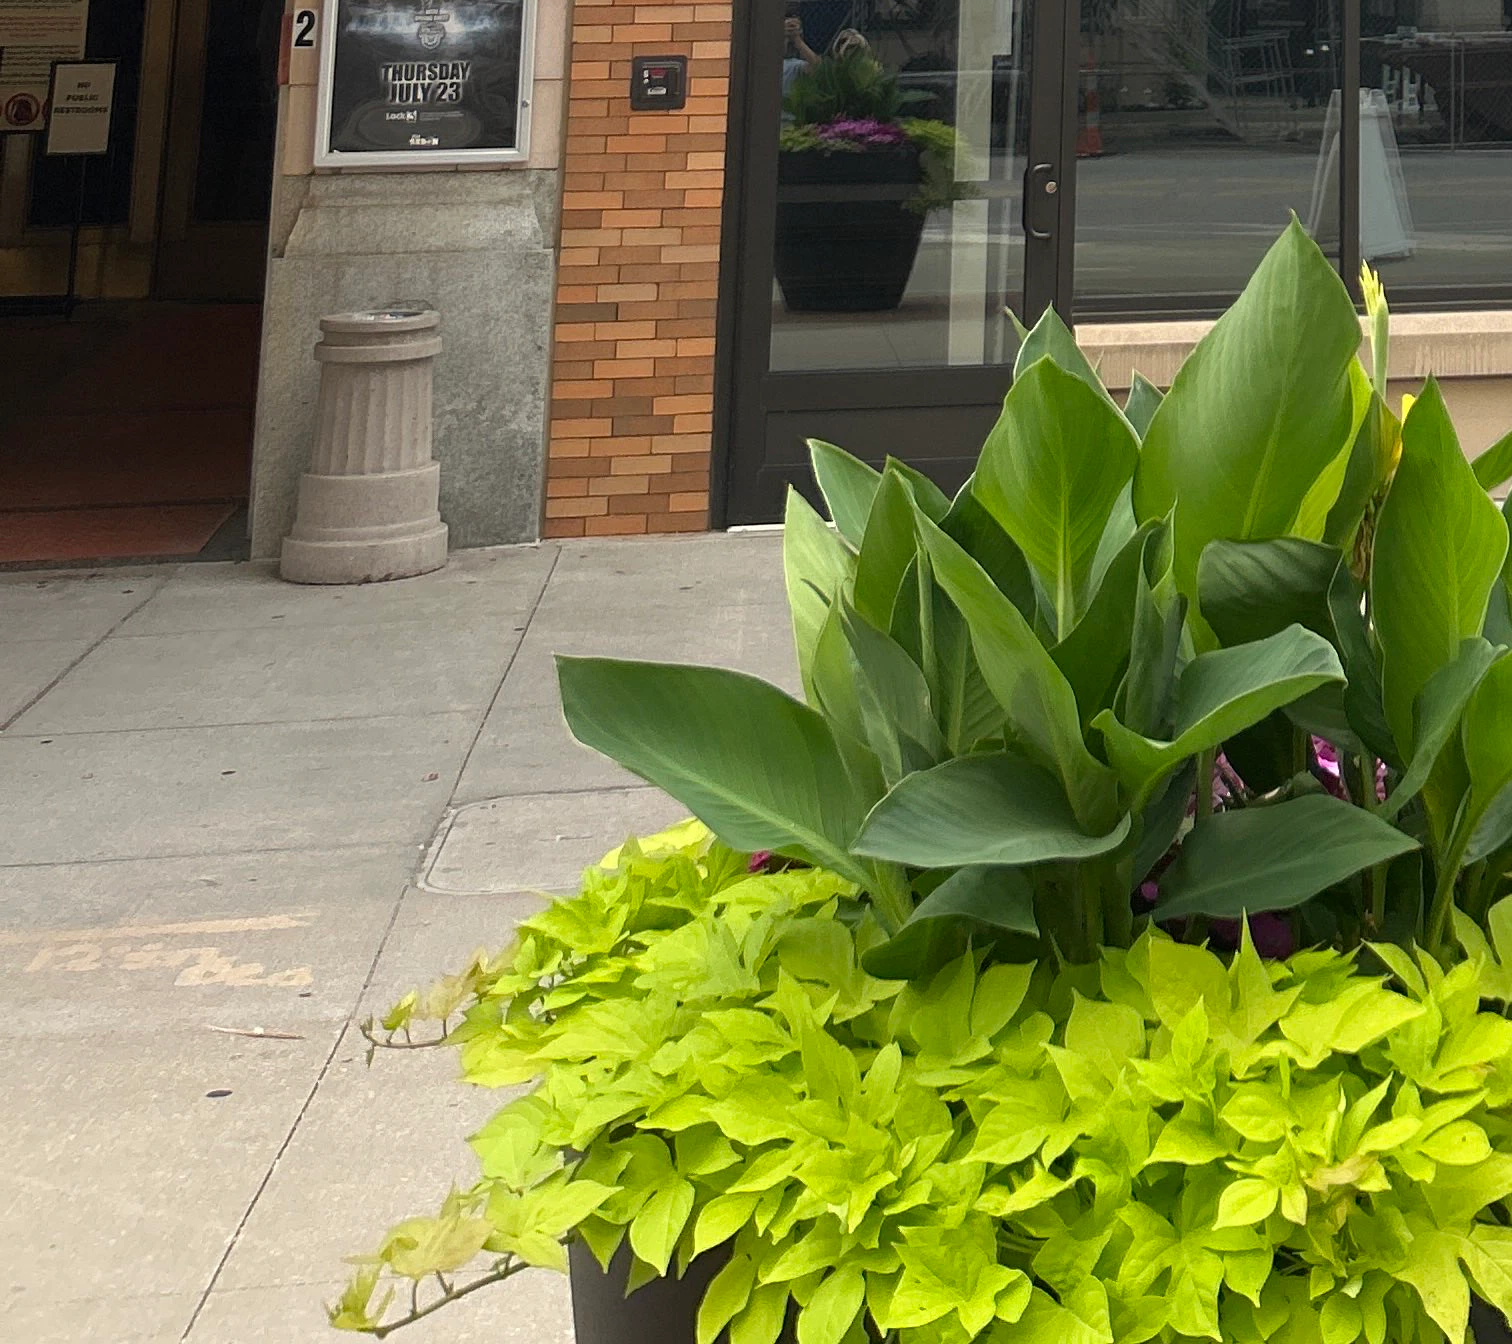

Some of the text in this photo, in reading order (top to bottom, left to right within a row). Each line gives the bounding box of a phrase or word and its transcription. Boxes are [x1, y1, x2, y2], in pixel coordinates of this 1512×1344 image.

[294, 10, 316, 48] 2
[381, 62, 471, 82] THURSDAY
[388, 82, 462, 103] JULY 23
